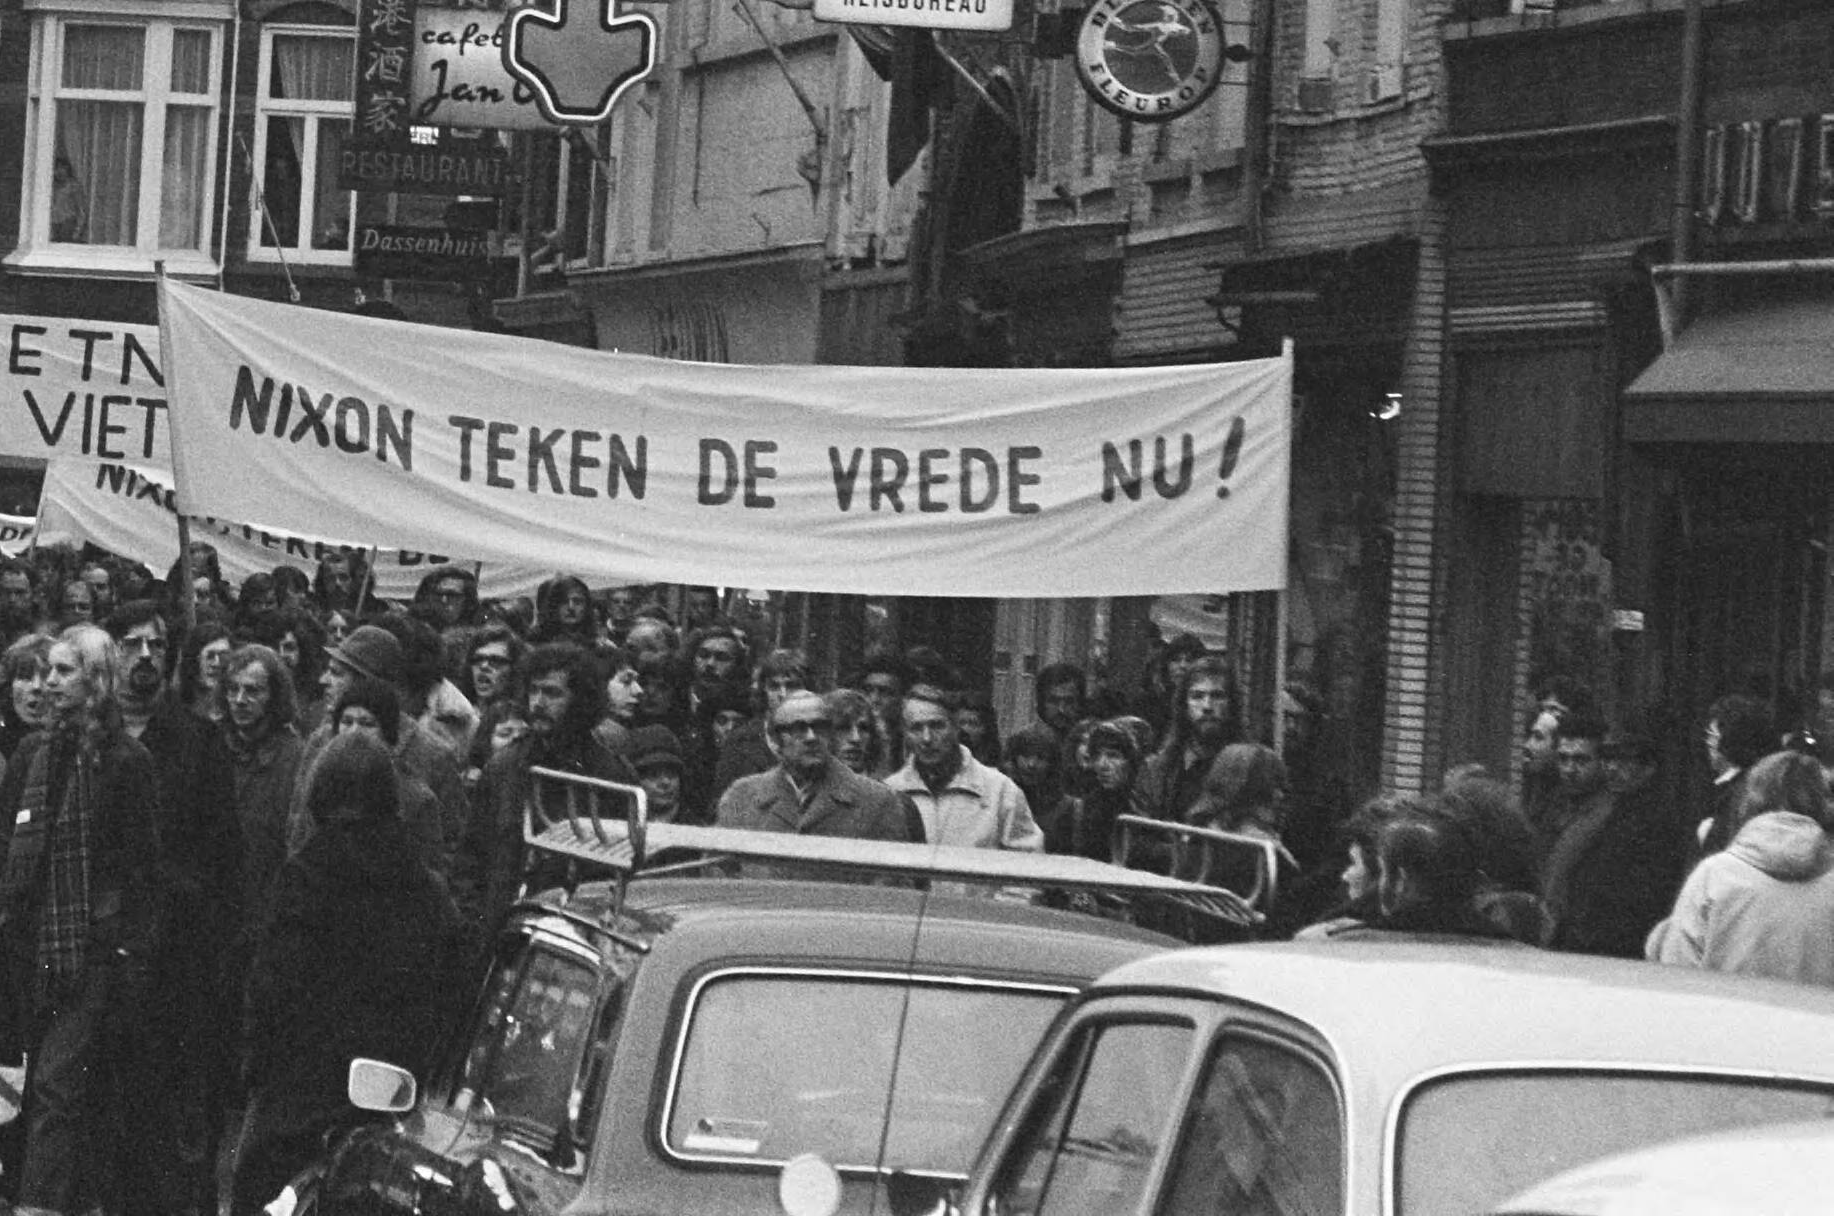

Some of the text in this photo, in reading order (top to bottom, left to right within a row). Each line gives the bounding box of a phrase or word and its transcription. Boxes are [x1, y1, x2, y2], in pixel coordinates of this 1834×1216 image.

[1088, 63, 1208, 112] FLEUROP
[342, 150, 503, 185] RESTAURANT
[229, 364, 1246, 514] NIXON TEKEN DE VREDE NU!
